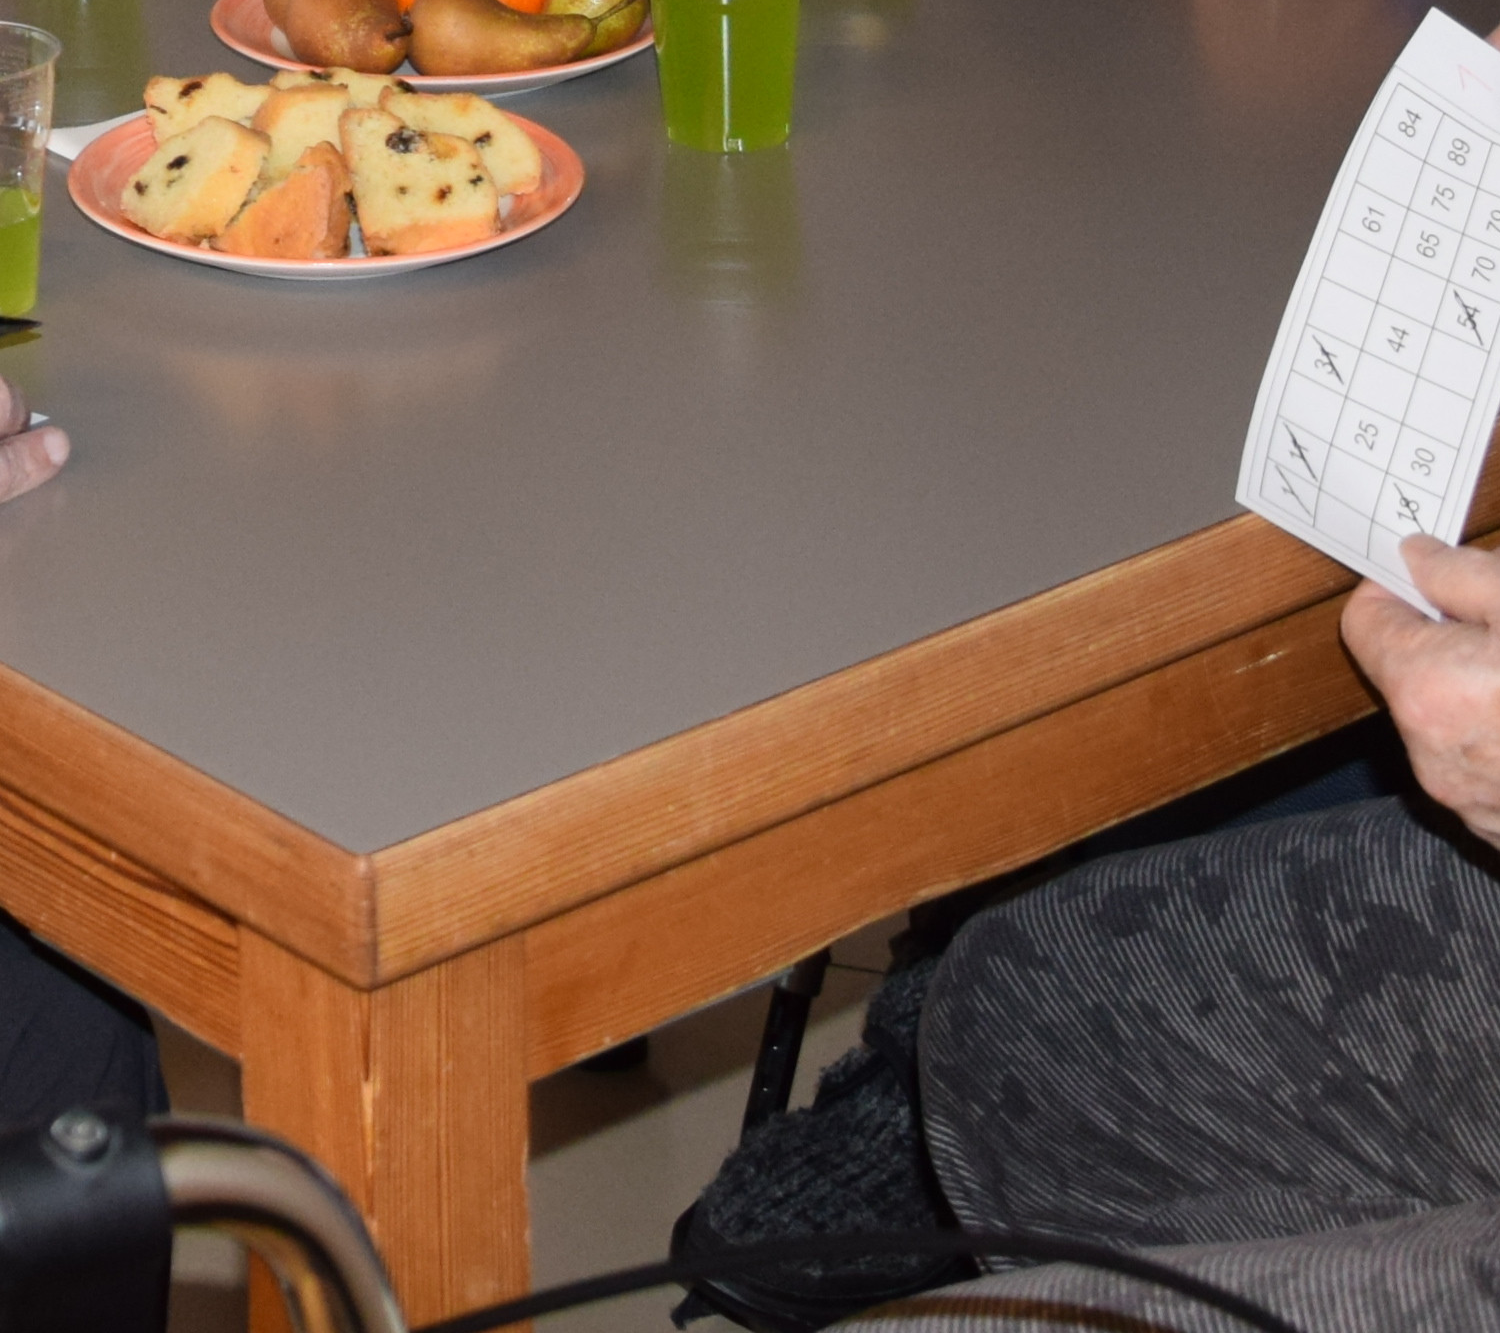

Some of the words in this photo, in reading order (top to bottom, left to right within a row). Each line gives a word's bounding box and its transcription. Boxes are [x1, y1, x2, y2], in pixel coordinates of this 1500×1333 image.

[1361, 205, 1385, 234] 61
[1398, 108, 1422, 138] 84
[1354, 420, 1379, 451] 25
[1387, 325, 1411, 353] 44
[1416, 231, 1440, 259] 65
[1431, 184, 1456, 213] 75
[1447, 137, 1471, 167] 89
[1410, 447, 1436, 477] 30
[1471, 255, 1496, 283] 70
